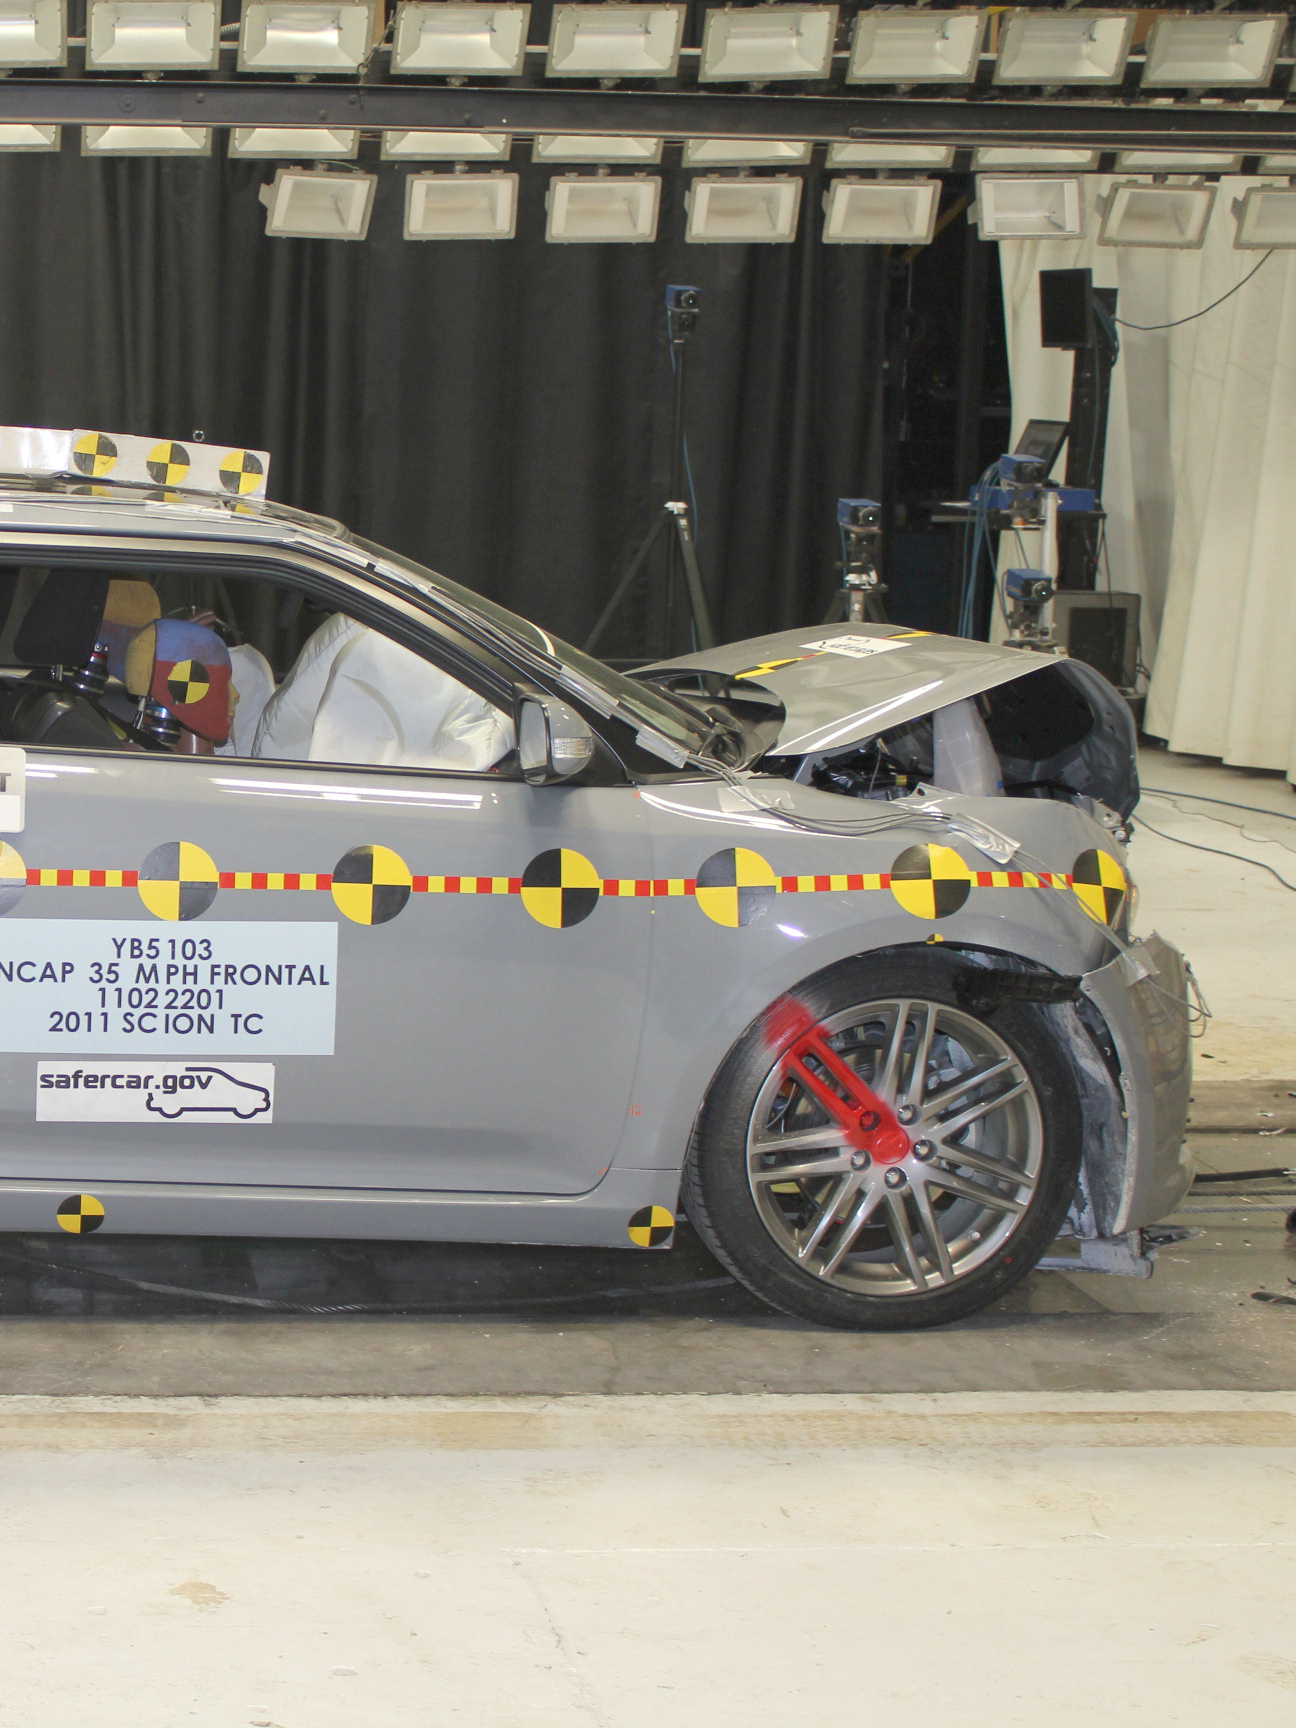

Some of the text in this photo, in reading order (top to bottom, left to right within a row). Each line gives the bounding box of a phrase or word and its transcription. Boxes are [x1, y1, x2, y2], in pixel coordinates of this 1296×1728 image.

[111, 937, 213, 960] YB5103
[88, 962, 120, 984] 35
[135, 963, 199, 985] MPH
[209, 964, 330, 986] FRONTAL
[97, 987, 224, 1010] 11022201
[48, 1011, 264, 1035] 2011 SCION TC
[39, 1069, 213, 1095] safercar.gov
